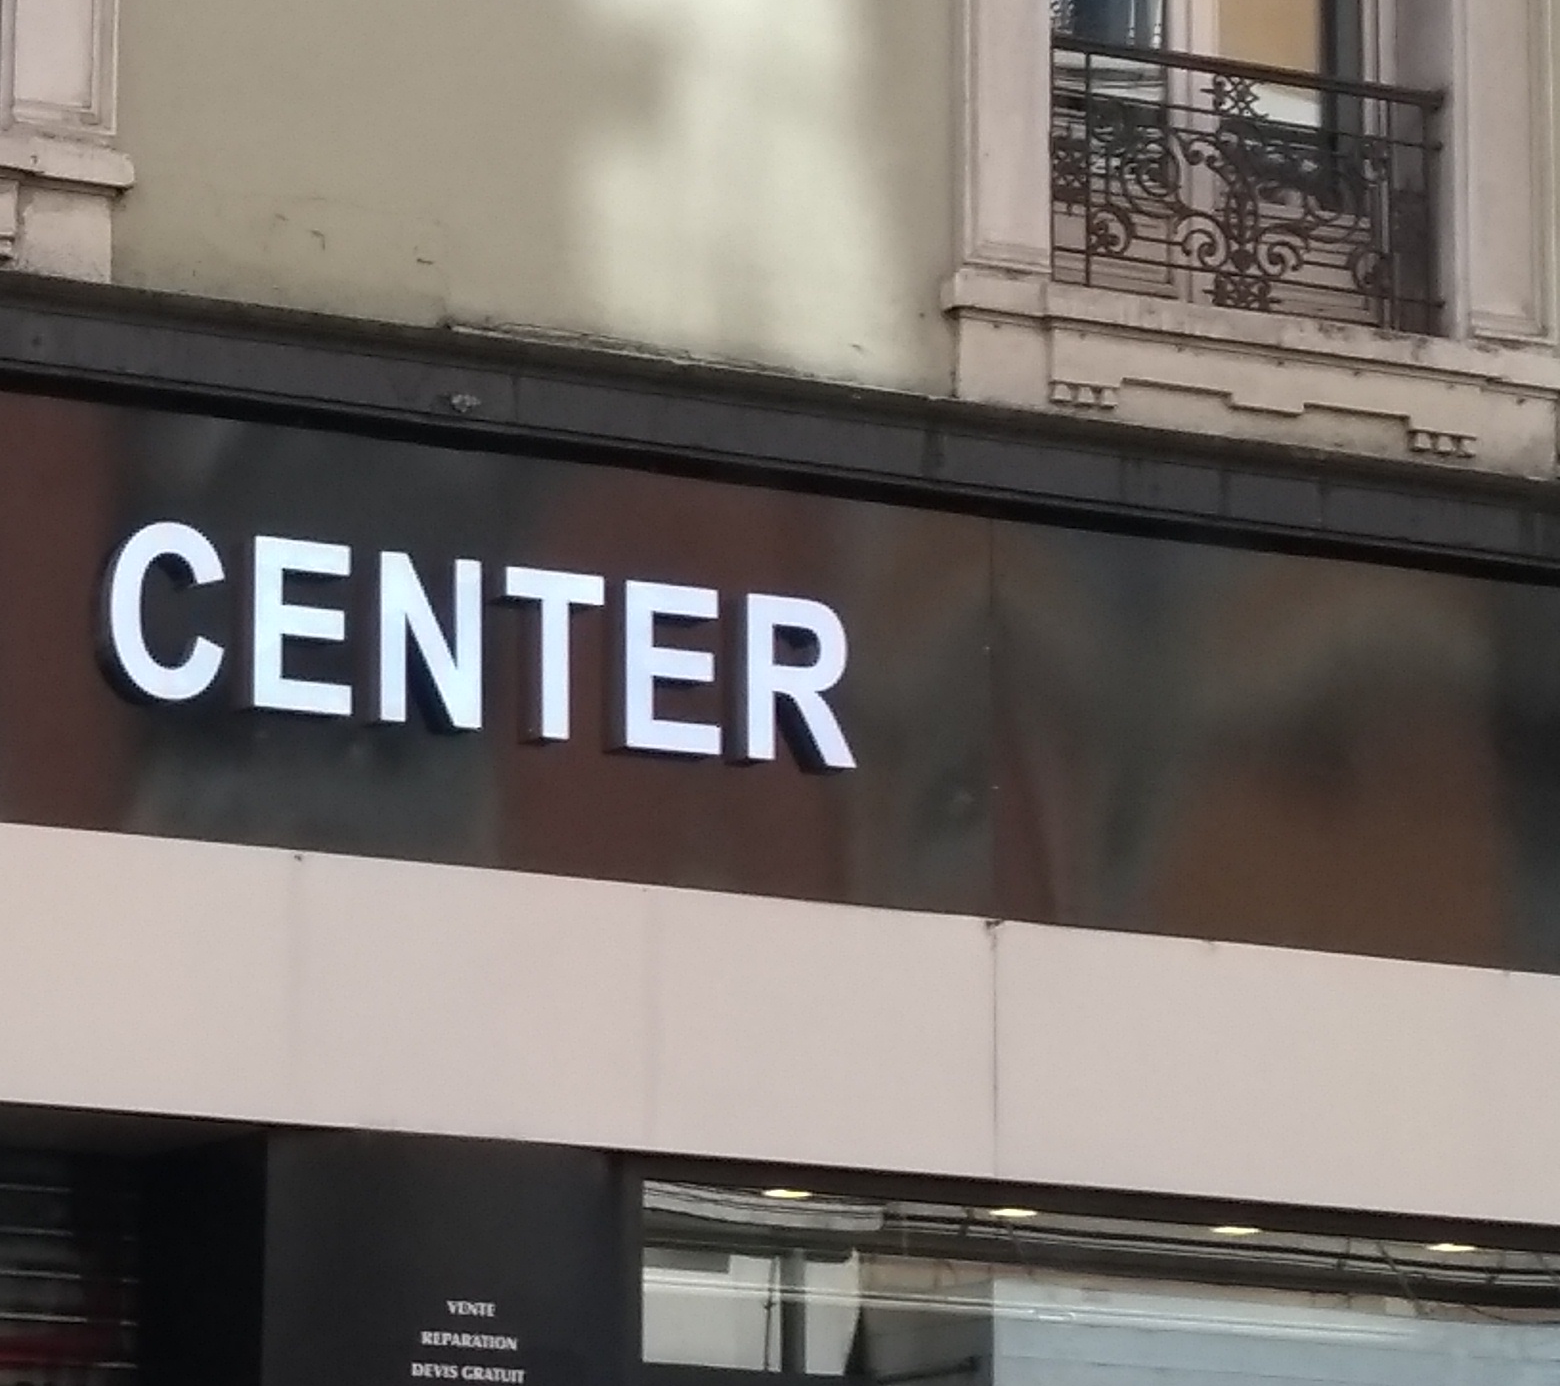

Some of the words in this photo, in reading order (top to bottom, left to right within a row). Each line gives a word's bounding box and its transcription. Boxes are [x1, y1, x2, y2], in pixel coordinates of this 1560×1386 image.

[103, 520, 857, 770] CENTER
[447, 1300, 495, 1316] VENTE
[421, 1331, 518, 1351] REPARATION
[411, 1363, 458, 1379] DEVIS
[461, 1366, 525, 1384] GRATUIT
